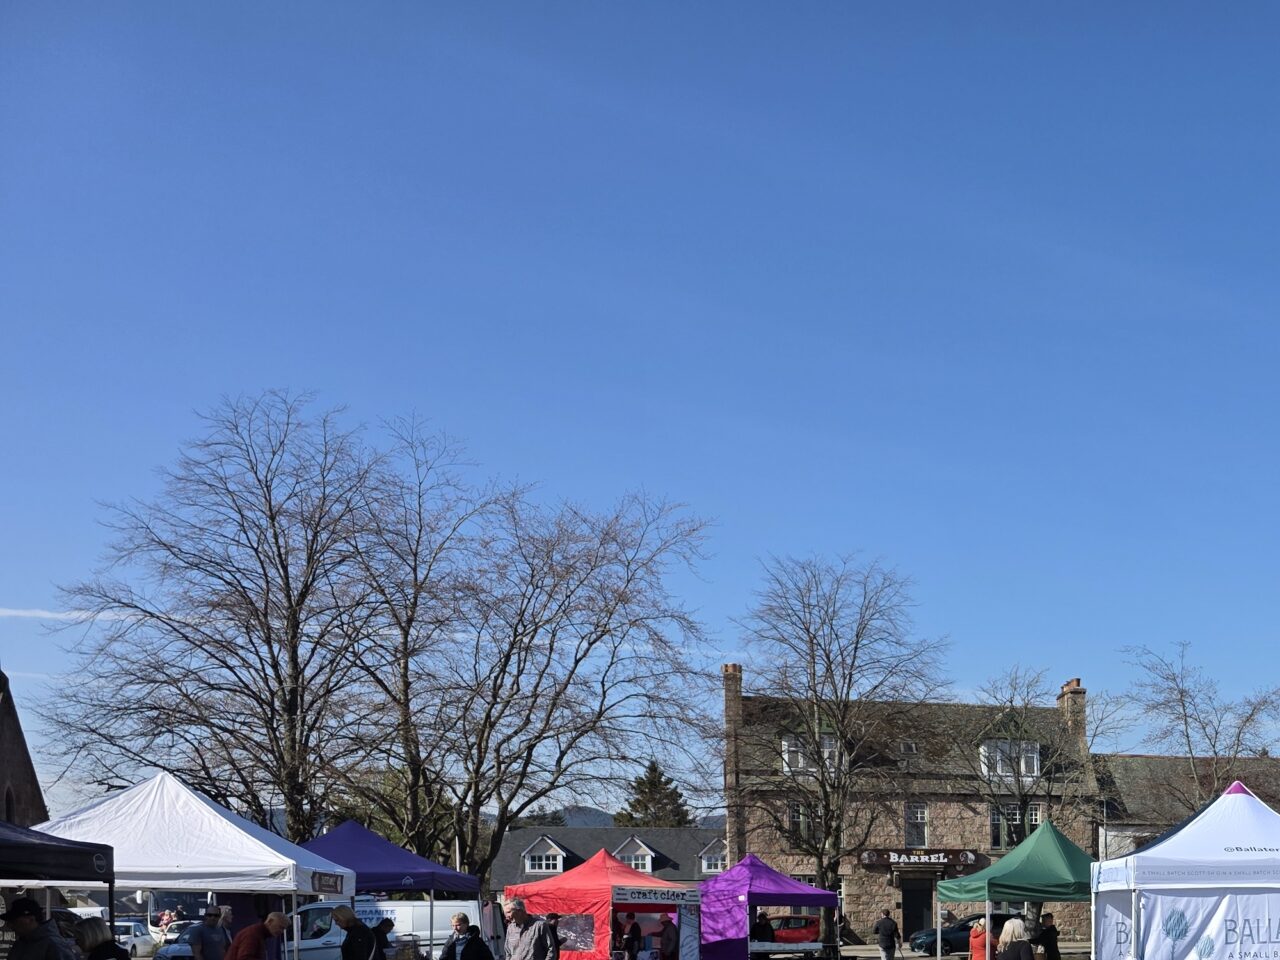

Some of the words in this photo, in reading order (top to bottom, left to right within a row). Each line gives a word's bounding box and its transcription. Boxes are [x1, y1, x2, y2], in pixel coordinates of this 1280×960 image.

[889, 851, 948, 863] BARREL
[630, 889, 659, 900] craft
[660, 889, 687, 901] cider
[1228, 951, 1234, 959] A
[1238, 951, 1270, 959] SMALL
